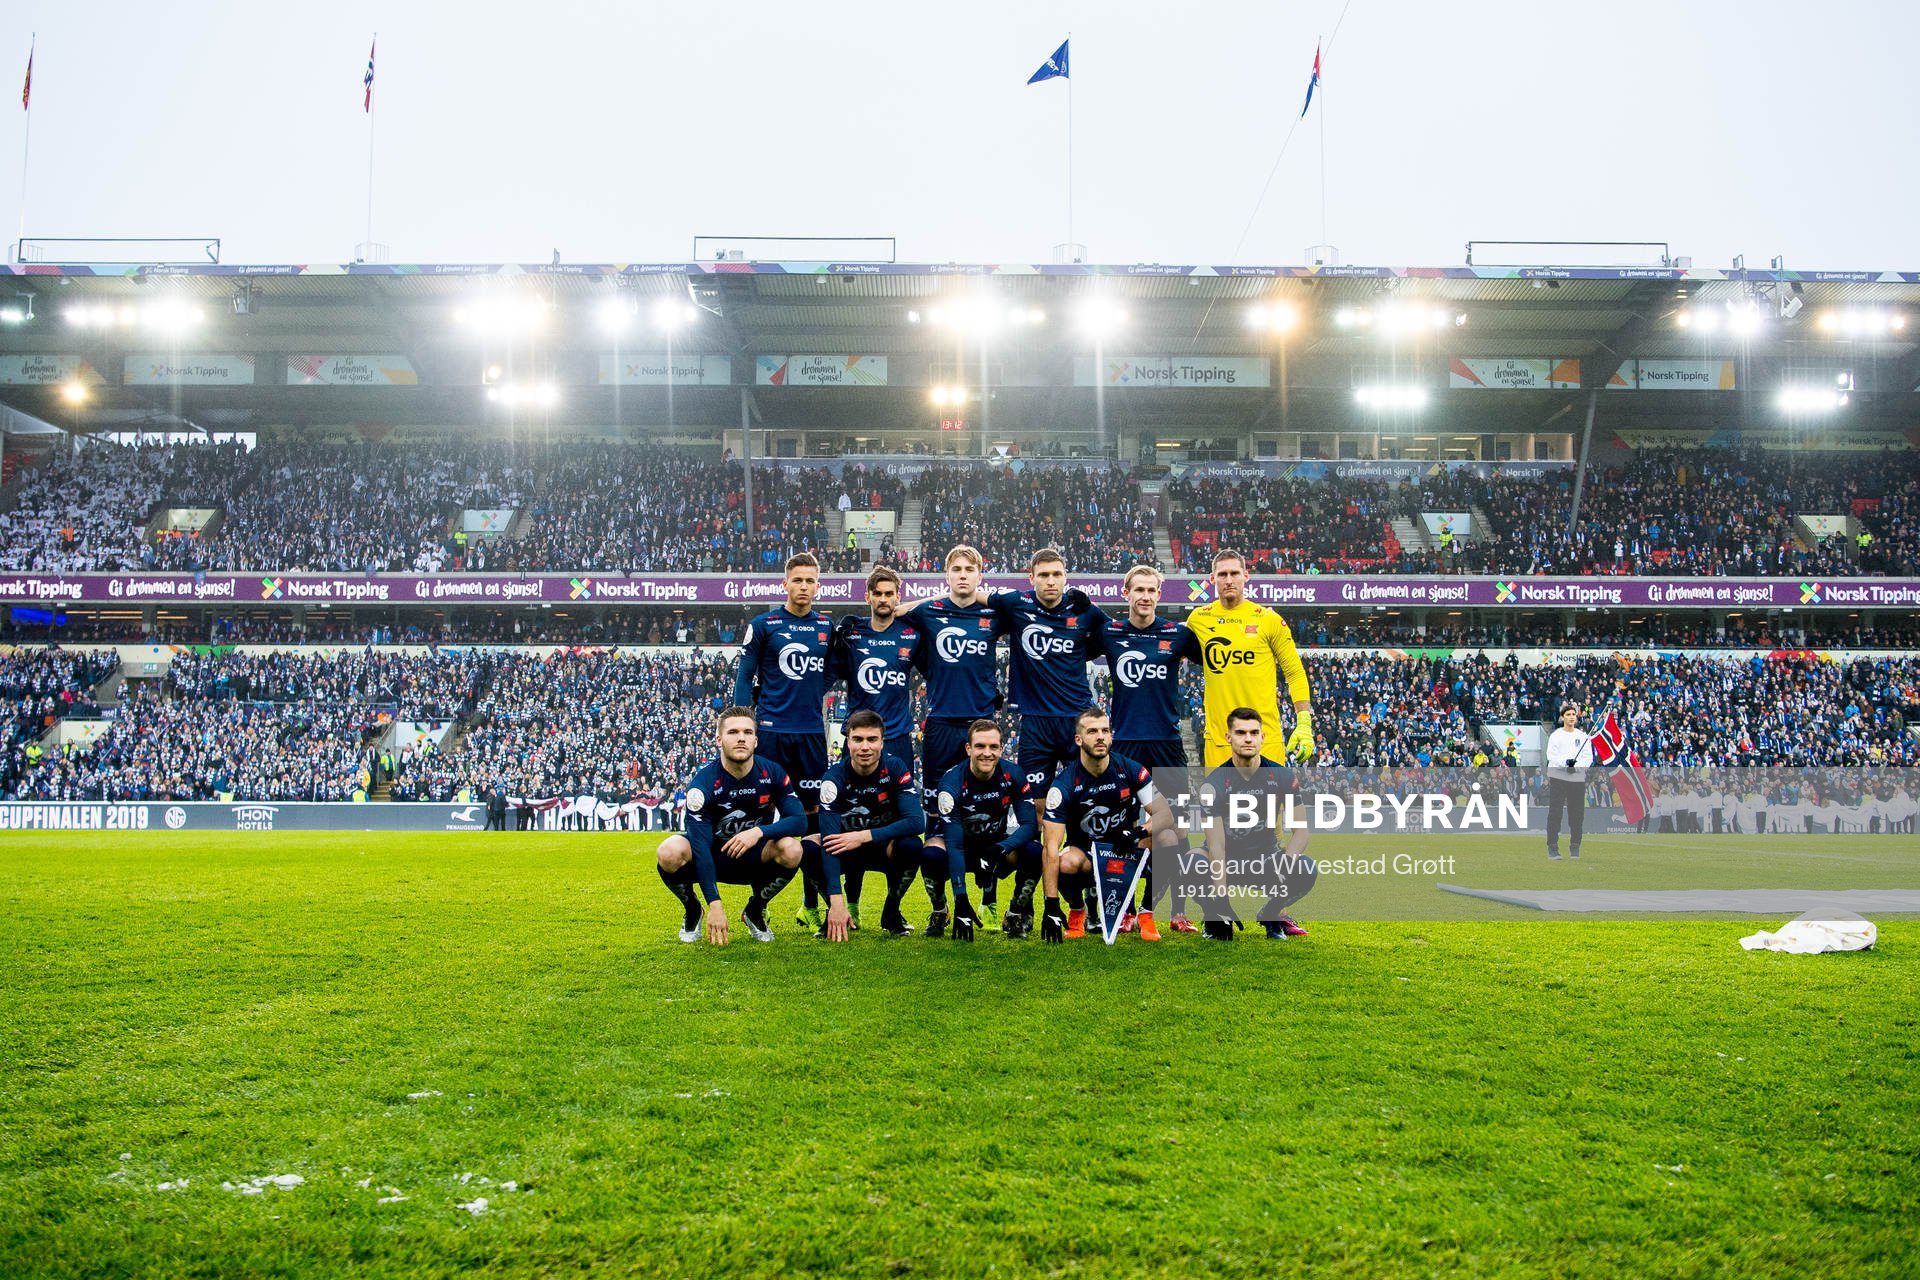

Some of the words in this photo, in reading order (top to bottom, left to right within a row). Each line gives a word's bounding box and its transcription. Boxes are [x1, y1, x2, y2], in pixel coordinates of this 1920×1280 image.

[166, 366, 192, 376] Norsk
[194, 366, 228, 378] Tipping
[642, 366, 668, 376] Norsk
[670, 366, 704, 378] Tipping
[817, 371, 842, 384] sjanse!
[1135, 366, 1178, 379] Norsk
[1181, 366, 1235, 383] Tipping
[1648, 371, 1674, 380] Norsk
[1675, 371, 1709, 382] Tipping
[1510, 374, 1535, 388] sjanse!
[942, 420, 963, 430] 13:12
[1208, 467, 1233, 476] Norsk
[1235, 467, 1264, 477] Tipping
[1336, 466, 1346, 477] Gi
[1506, 468, 1530, 477] Norsk
[0, 580, 26, 596] rsk
[27, 580, 82, 598] Tipping
[108, 580, 122, 597] Gi
[126, 578, 174, 597] drømmen
[178, 583, 192, 595] en
[194, 578, 236, 598] sjanse!
[288, 582, 332, 596] Norsk
[334, 582, 388, 600] Tipping
[416, 580, 430, 598] Gi
[433, 580, 482, 598] drømmen
[485, 583, 500, 596] en
[502, 580, 543, 600] sjanse!
[596, 582, 640, 597] Norsk
[642, 582, 698, 600] Tipping
[724, 580, 738, 598] Gi
[742, 580, 787, 598] drømme
[815, 580, 852, 600] janse!
[906, 582, 950, 597] Norsk
[1104, 585, 1118, 597] en
[1259, 584, 1315, 601] Tipping
[1342, 583, 1356, 600] Gi
[1360, 582, 1408, 600] drømmen
[1412, 586, 1426, 598] en
[1428, 583, 1468, 602] sjanse!
[1522, 586, 1564, 600] Norsk
[1566, 586, 1622, 604] Tipping
[1648, 584, 1662, 602] Gi
[1666, 584, 1714, 602] drømmen
[1716, 588, 1730, 600] en
[1734, 584, 1774, 604] sjanse!
[1826, 586, 1868, 600] Norsk
[1099, 783, 1116, 792] OBOS
[0, 806, 101, 829] CUPFINALEN
[106, 806, 148, 830] 2019
[232, 806, 279, 821] THON
[237, 822, 273, 830] HOTELS
